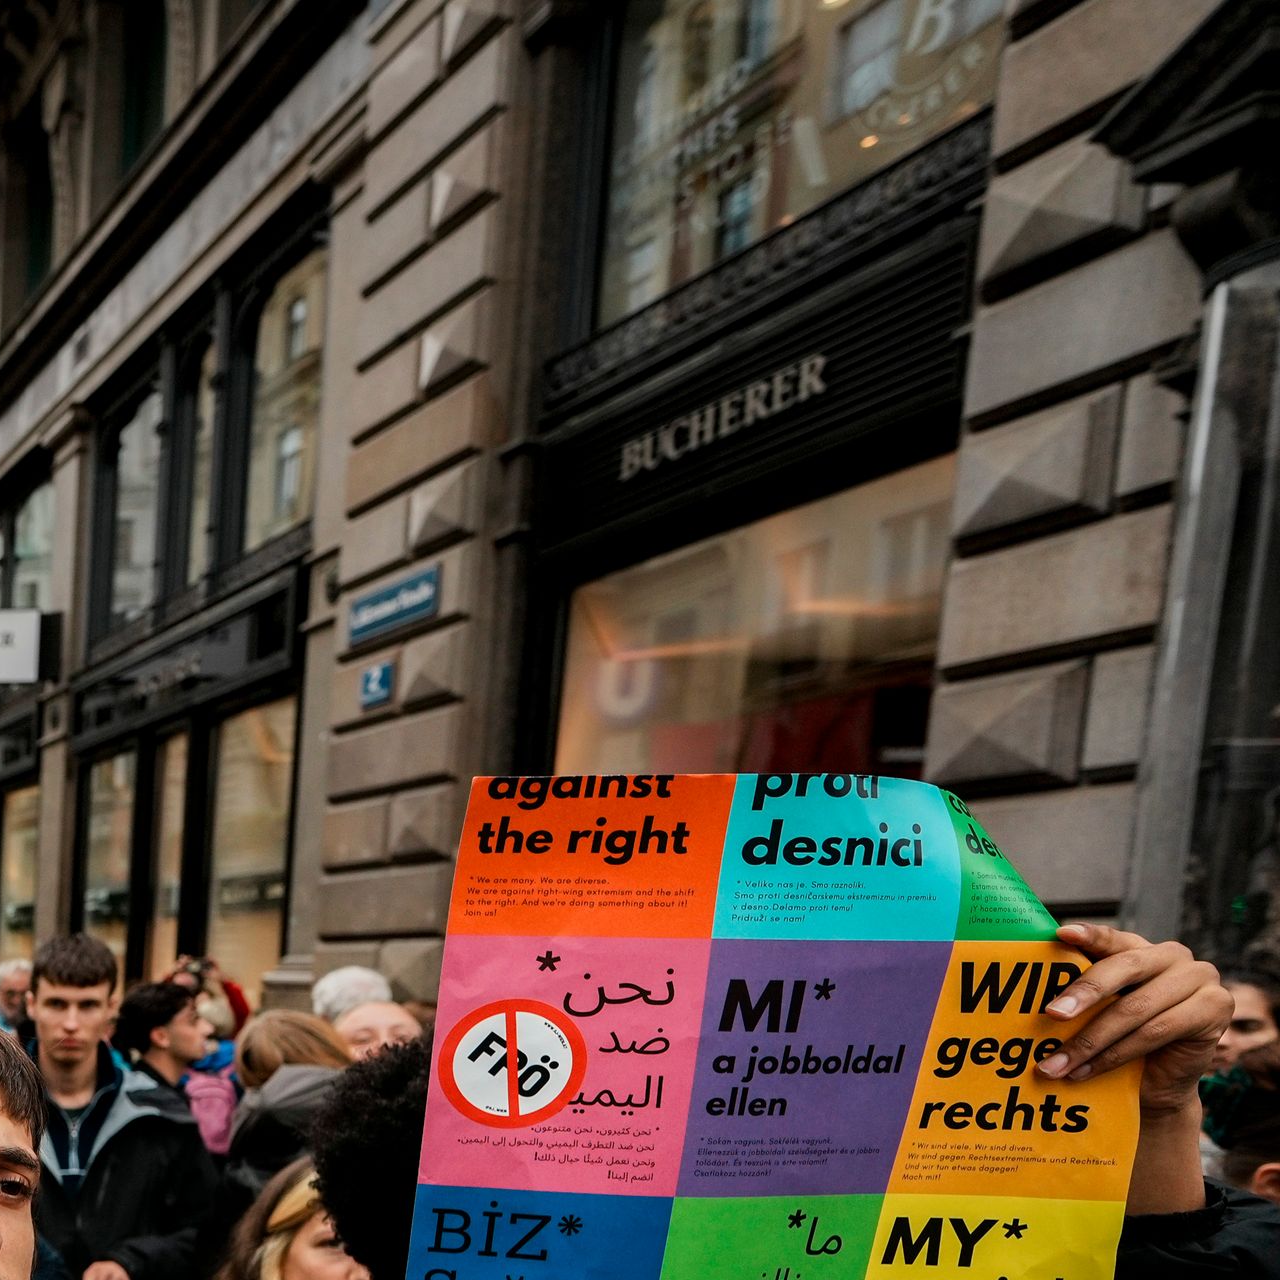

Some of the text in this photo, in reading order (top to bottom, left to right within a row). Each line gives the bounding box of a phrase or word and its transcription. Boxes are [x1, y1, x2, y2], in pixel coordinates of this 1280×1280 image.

[617, 353, 827, 483] BUCHERER
[478, 816, 689, 865] the right
[742, 819, 922, 866] desnici
[467, 1031, 560, 1098] FPÖ
